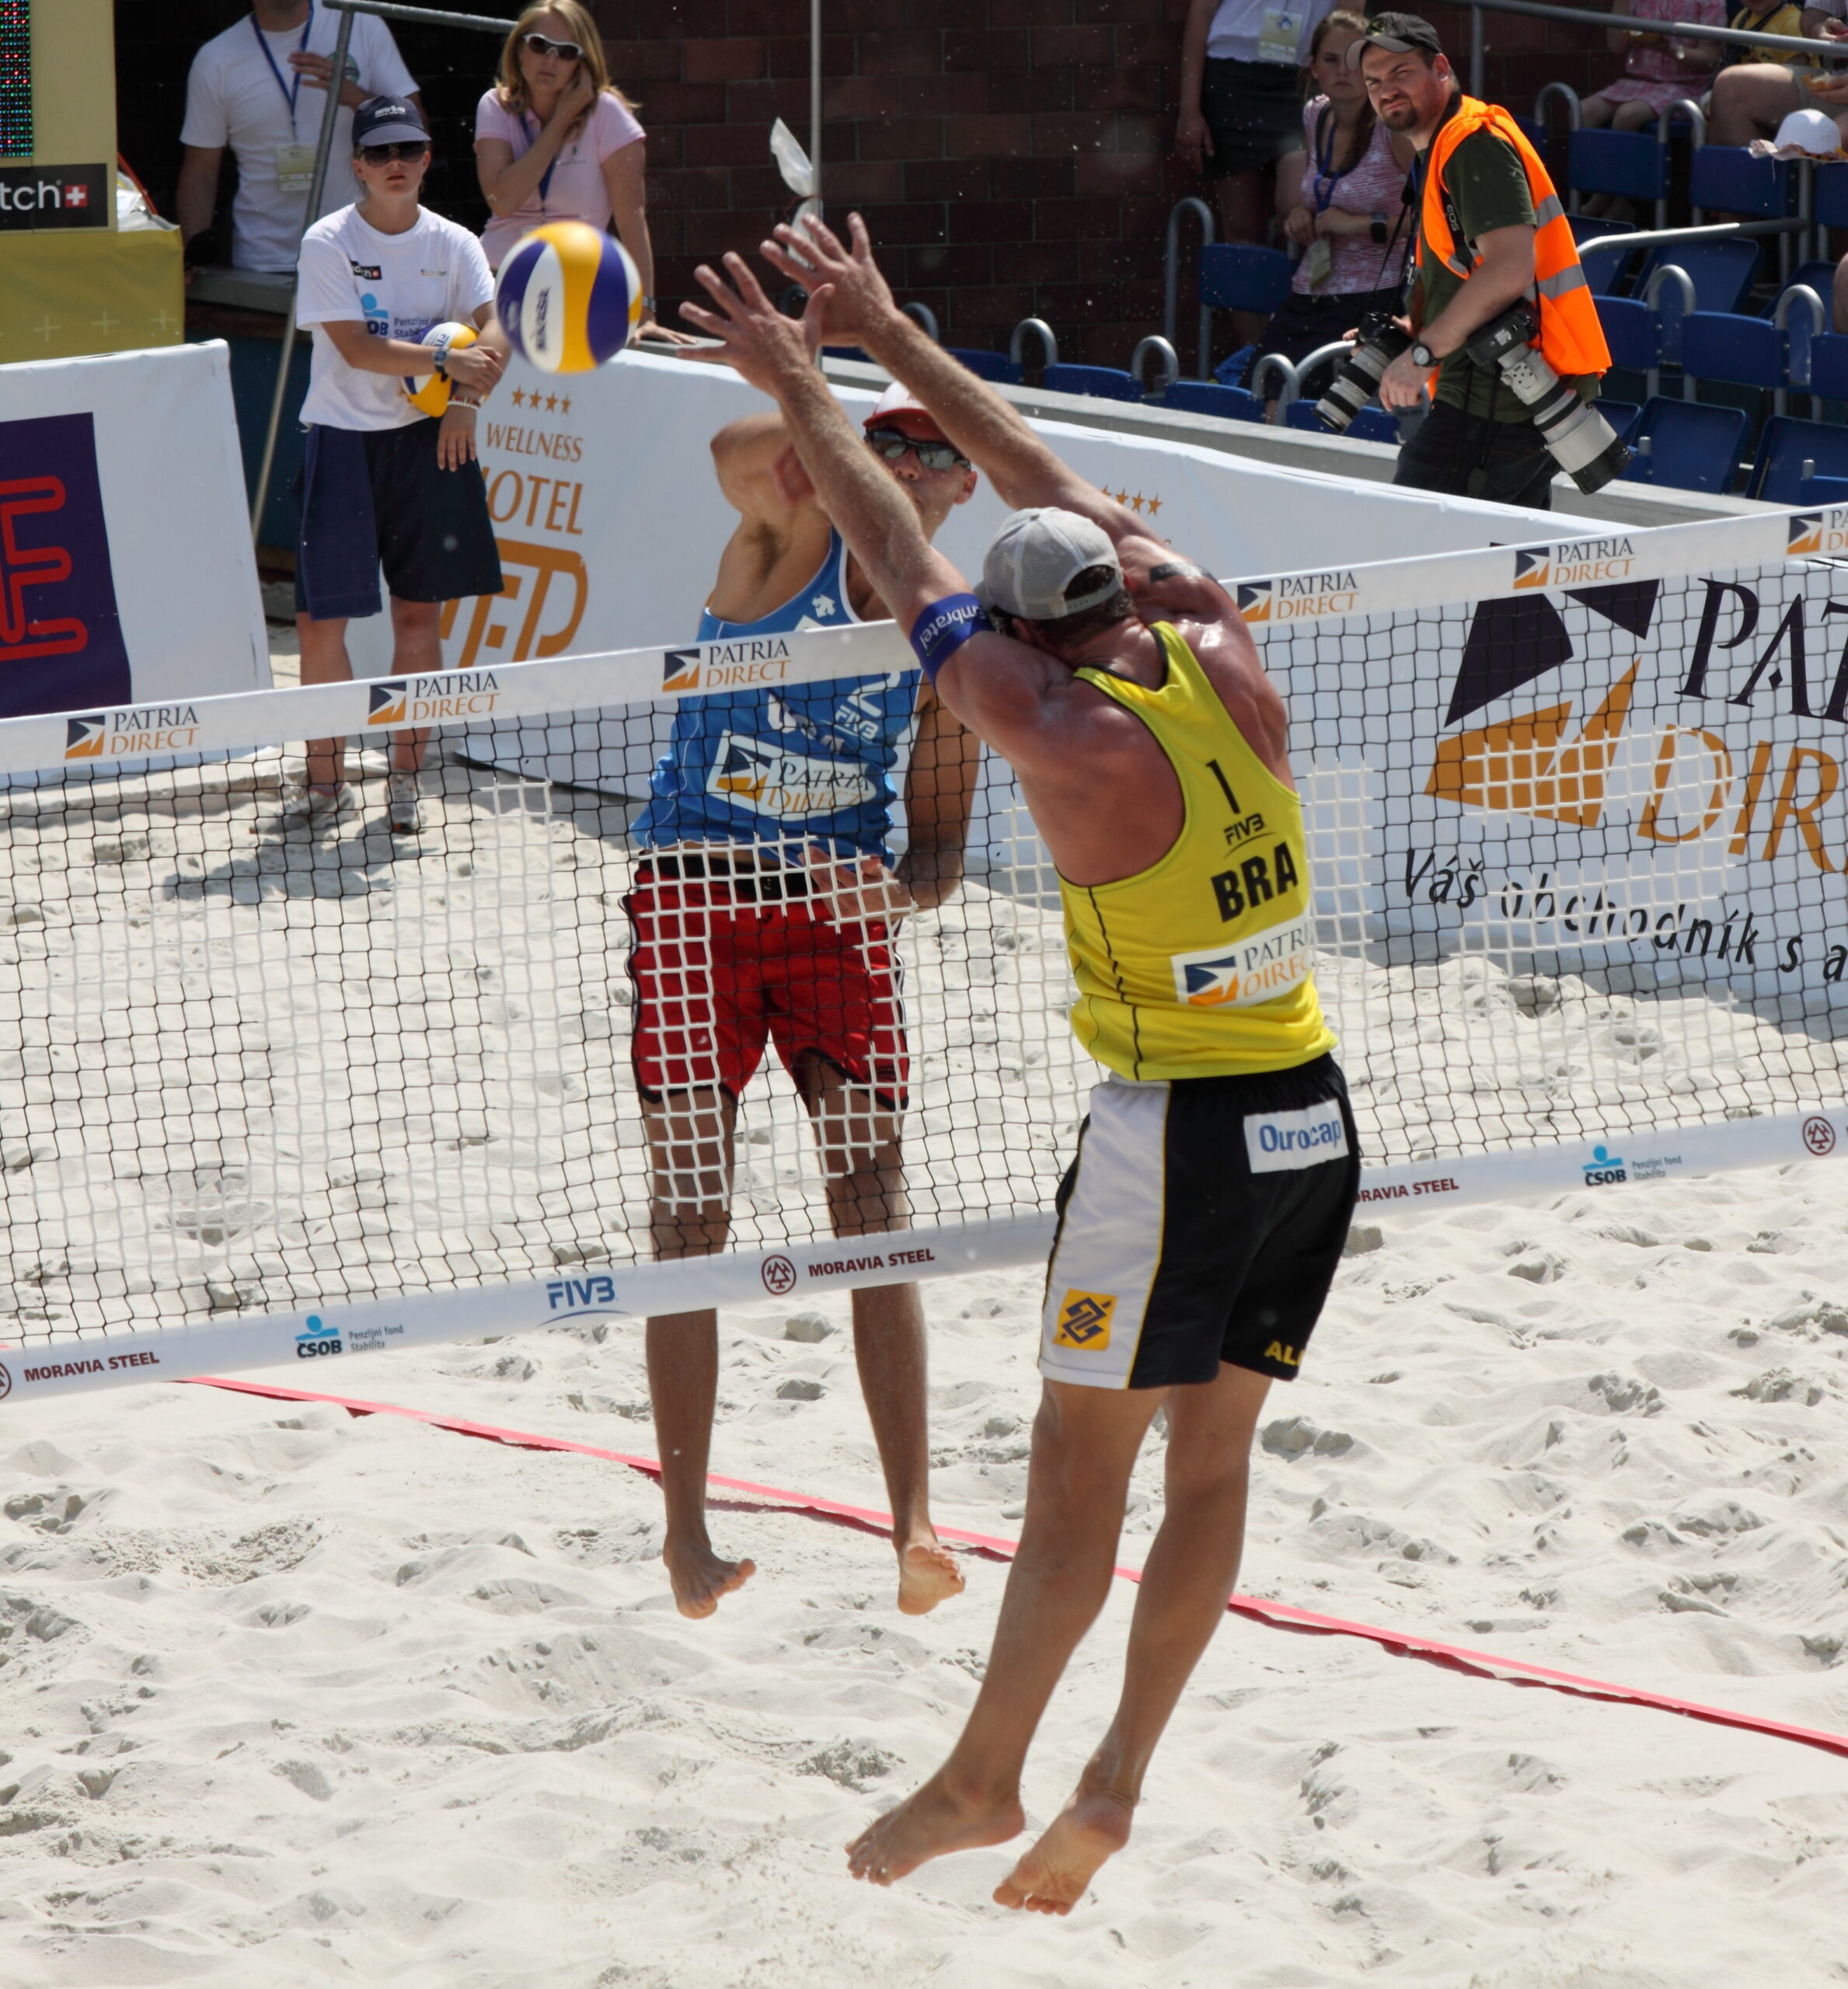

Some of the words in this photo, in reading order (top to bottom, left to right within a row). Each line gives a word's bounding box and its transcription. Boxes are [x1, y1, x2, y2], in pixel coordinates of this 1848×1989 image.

[1446, 204, 1460, 232] EOS
[367, 320, 389, 336] OB
[486, 422, 584, 463] WELLNESS
[1557, 537, 1635, 564] PATRIA
[1279, 571, 1358, 597] PATRIA
[1554, 558, 1635, 585] DIRECT
[1277, 592, 1359, 619] DIRECT
[708, 639, 790, 666] PATRIA
[414, 671, 499, 698] PATRIA
[706, 660, 791, 688] DIRECT
[113, 705, 200, 732] PATRIA
[413, 693, 500, 720] DIRECT
[835, 705, 879, 740] FIVB
[110, 727, 200, 755] DIRECT
[777, 761, 870, 792] PATRIA
[767, 788, 868, 813] DIRECT
[1637, 723, 1848, 876] DIR
[1224, 813, 1266, 845] FIVB
[1211, 841, 1299, 923] BRA
[1406, 848, 1482, 908] Váš
[1501, 873, 1759, 965] obchodník
[1779, 936, 1803, 973] s
[1823, 945, 1848, 981] a
[1244, 922, 1310, 971] PATRI
[1260, 1120, 1341, 1152] Ourocap
[1664, 1154, 1682, 1165] fond
[1355, 1185, 1409, 1204] ORAVIA
[1413, 1178, 1459, 1195] STEEL
[1585, 1169, 1627, 1186] ČSOB
[808, 1256, 884, 1277] MORAVIA
[888, 1248, 935, 1266] STEEL
[546, 1276, 615, 1310] FIVB
[384, 1324, 404, 1336] fond
[297, 1339, 342, 1359] ČSOB
[350, 1339, 385, 1353] Stabilita
[24, 1359, 104, 1381] MORAVIA
[108, 1351, 160, 1370] STEEL
